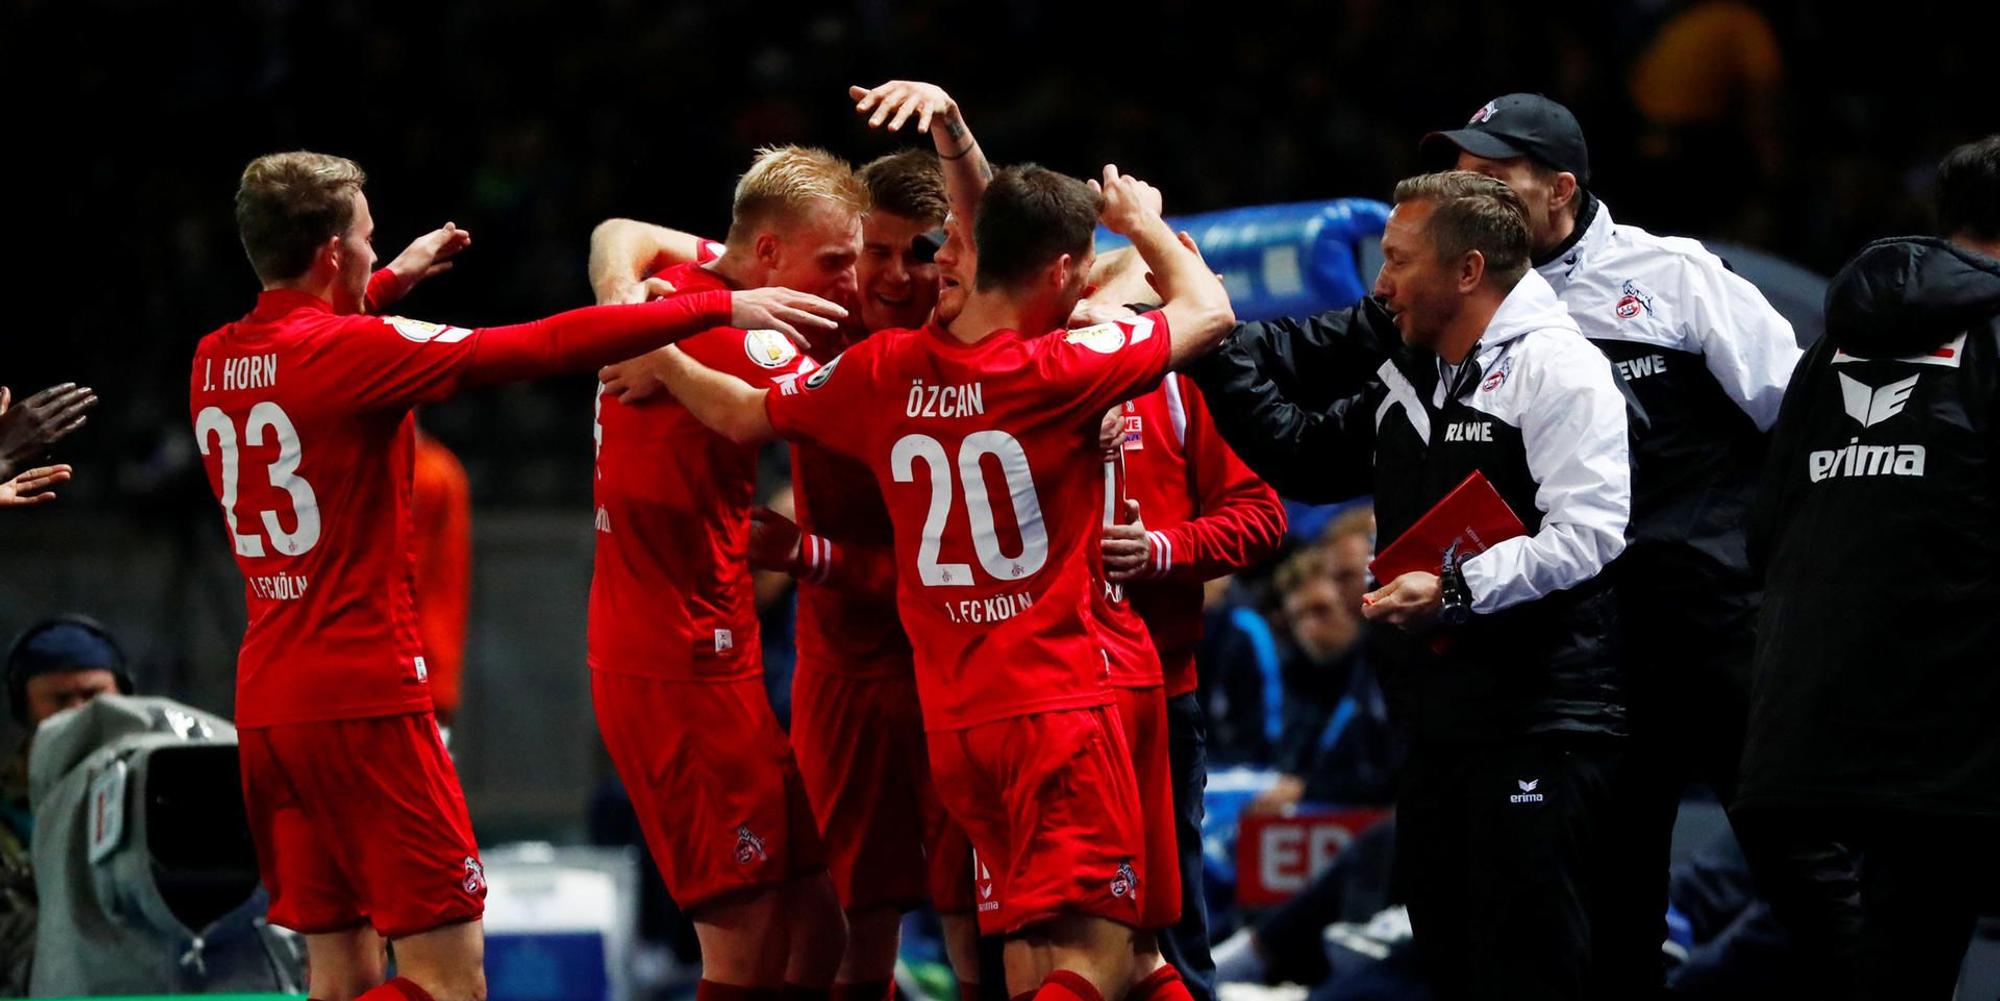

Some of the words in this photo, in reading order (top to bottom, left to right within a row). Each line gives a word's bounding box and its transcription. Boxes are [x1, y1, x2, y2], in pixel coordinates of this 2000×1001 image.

[203, 358, 215, 392] J.
[223, 353, 277, 391] HORN
[1615, 354, 1667, 381] EWE
[906, 379, 985, 418] ÖZCAN
[1809, 436, 1926, 483] erima
[195, 401, 321, 558] 23
[891, 430, 1049, 587] 20
[984, 591, 1034, 622] KÖLN
[1510, 791, 1544, 803] erima
